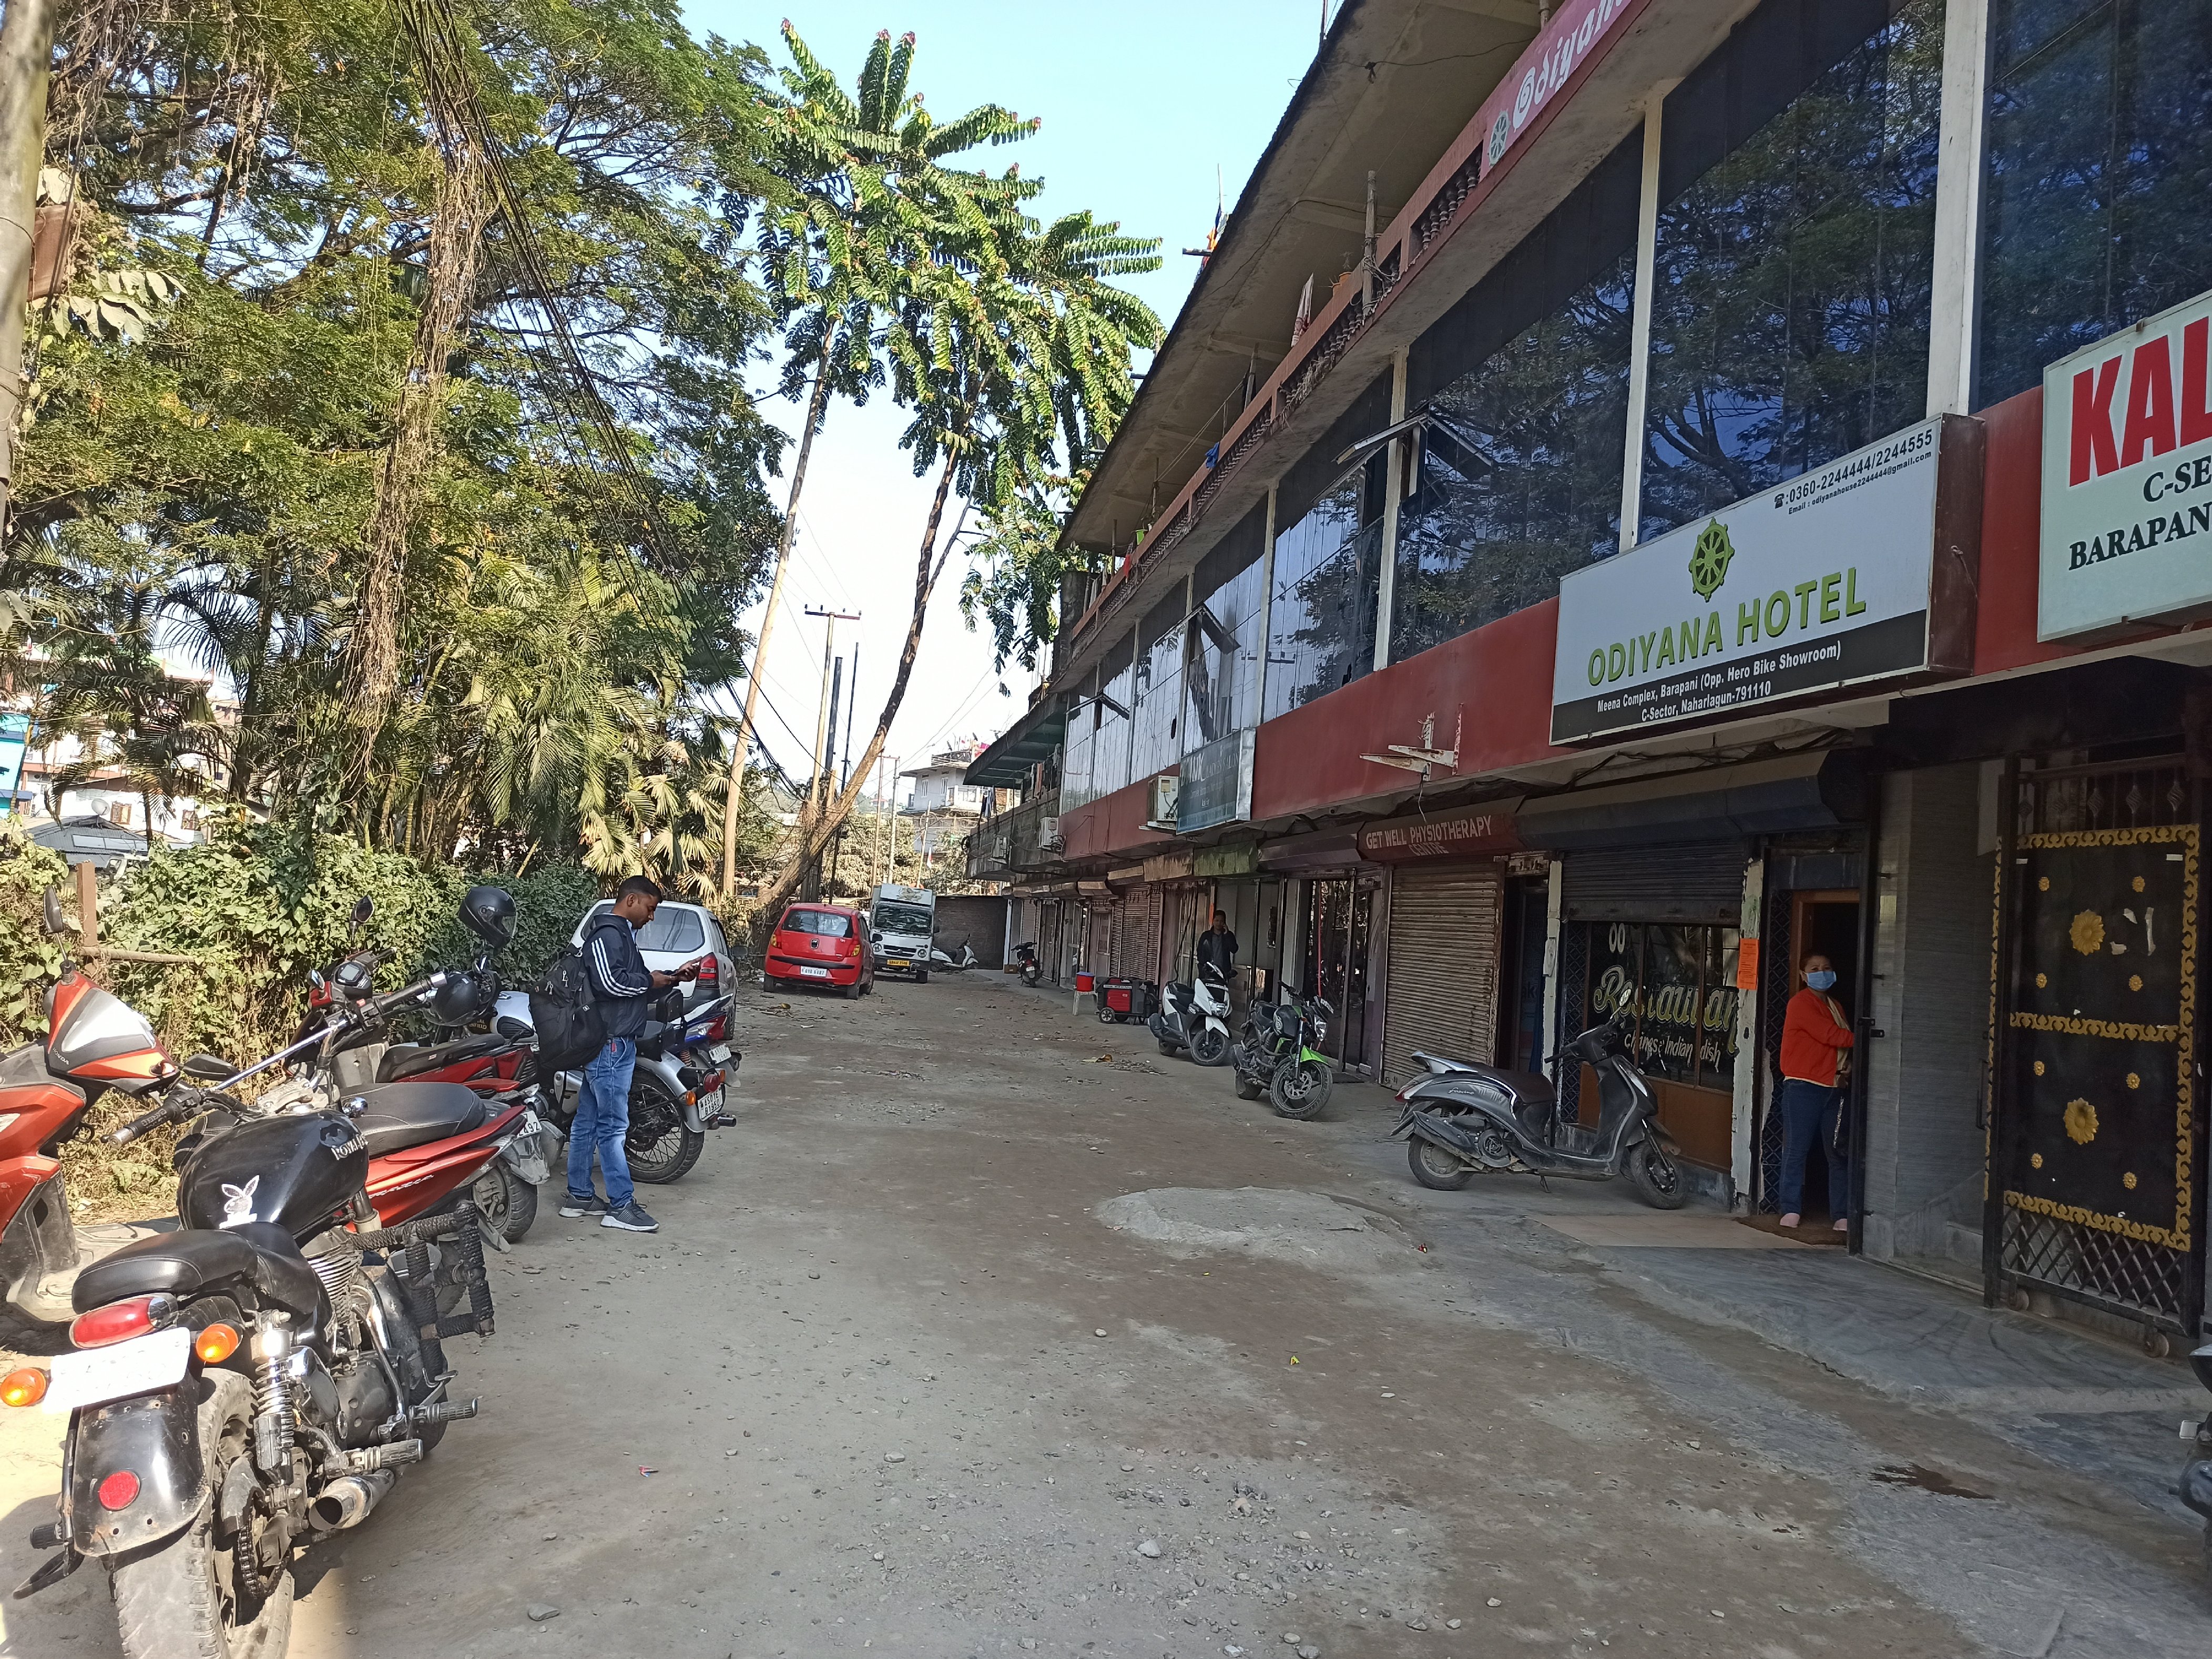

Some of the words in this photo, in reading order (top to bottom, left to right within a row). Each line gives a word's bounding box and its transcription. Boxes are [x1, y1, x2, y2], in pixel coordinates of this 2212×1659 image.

[1513, 0, 1623, 133] Odiyan
[1789, 502, 1806, 515] Email
[1588, 611, 1722, 686] ODIYANA
[1737, 567, 1866, 647] HOTEL
[1597, 699, 1620, 713] Meena
[1623, 689, 1658, 707] Complex,
[1660, 676, 1698, 698] Barapani
[1700, 673, 1724, 691] (Opp.
[1727, 666, 1750, 682] Hero
[1753, 659, 1776, 676] Bike
[1779, 640, 1841, 670] Showroom)
[1642, 705, 1679, 722] C-Sector,
[1681, 680, 1771, 713] Naharlagun-791110
[1367, 831, 1383, 850] GET
[1384, 828, 1407, 847] WELL
[1409, 815, 1492, 843] PHYSIOTHERAPY
[1408, 842, 1450, 857] CENTRE
[1665, 1035, 1694, 1061] Indian
[1699, 1039, 1721, 1066] dish
